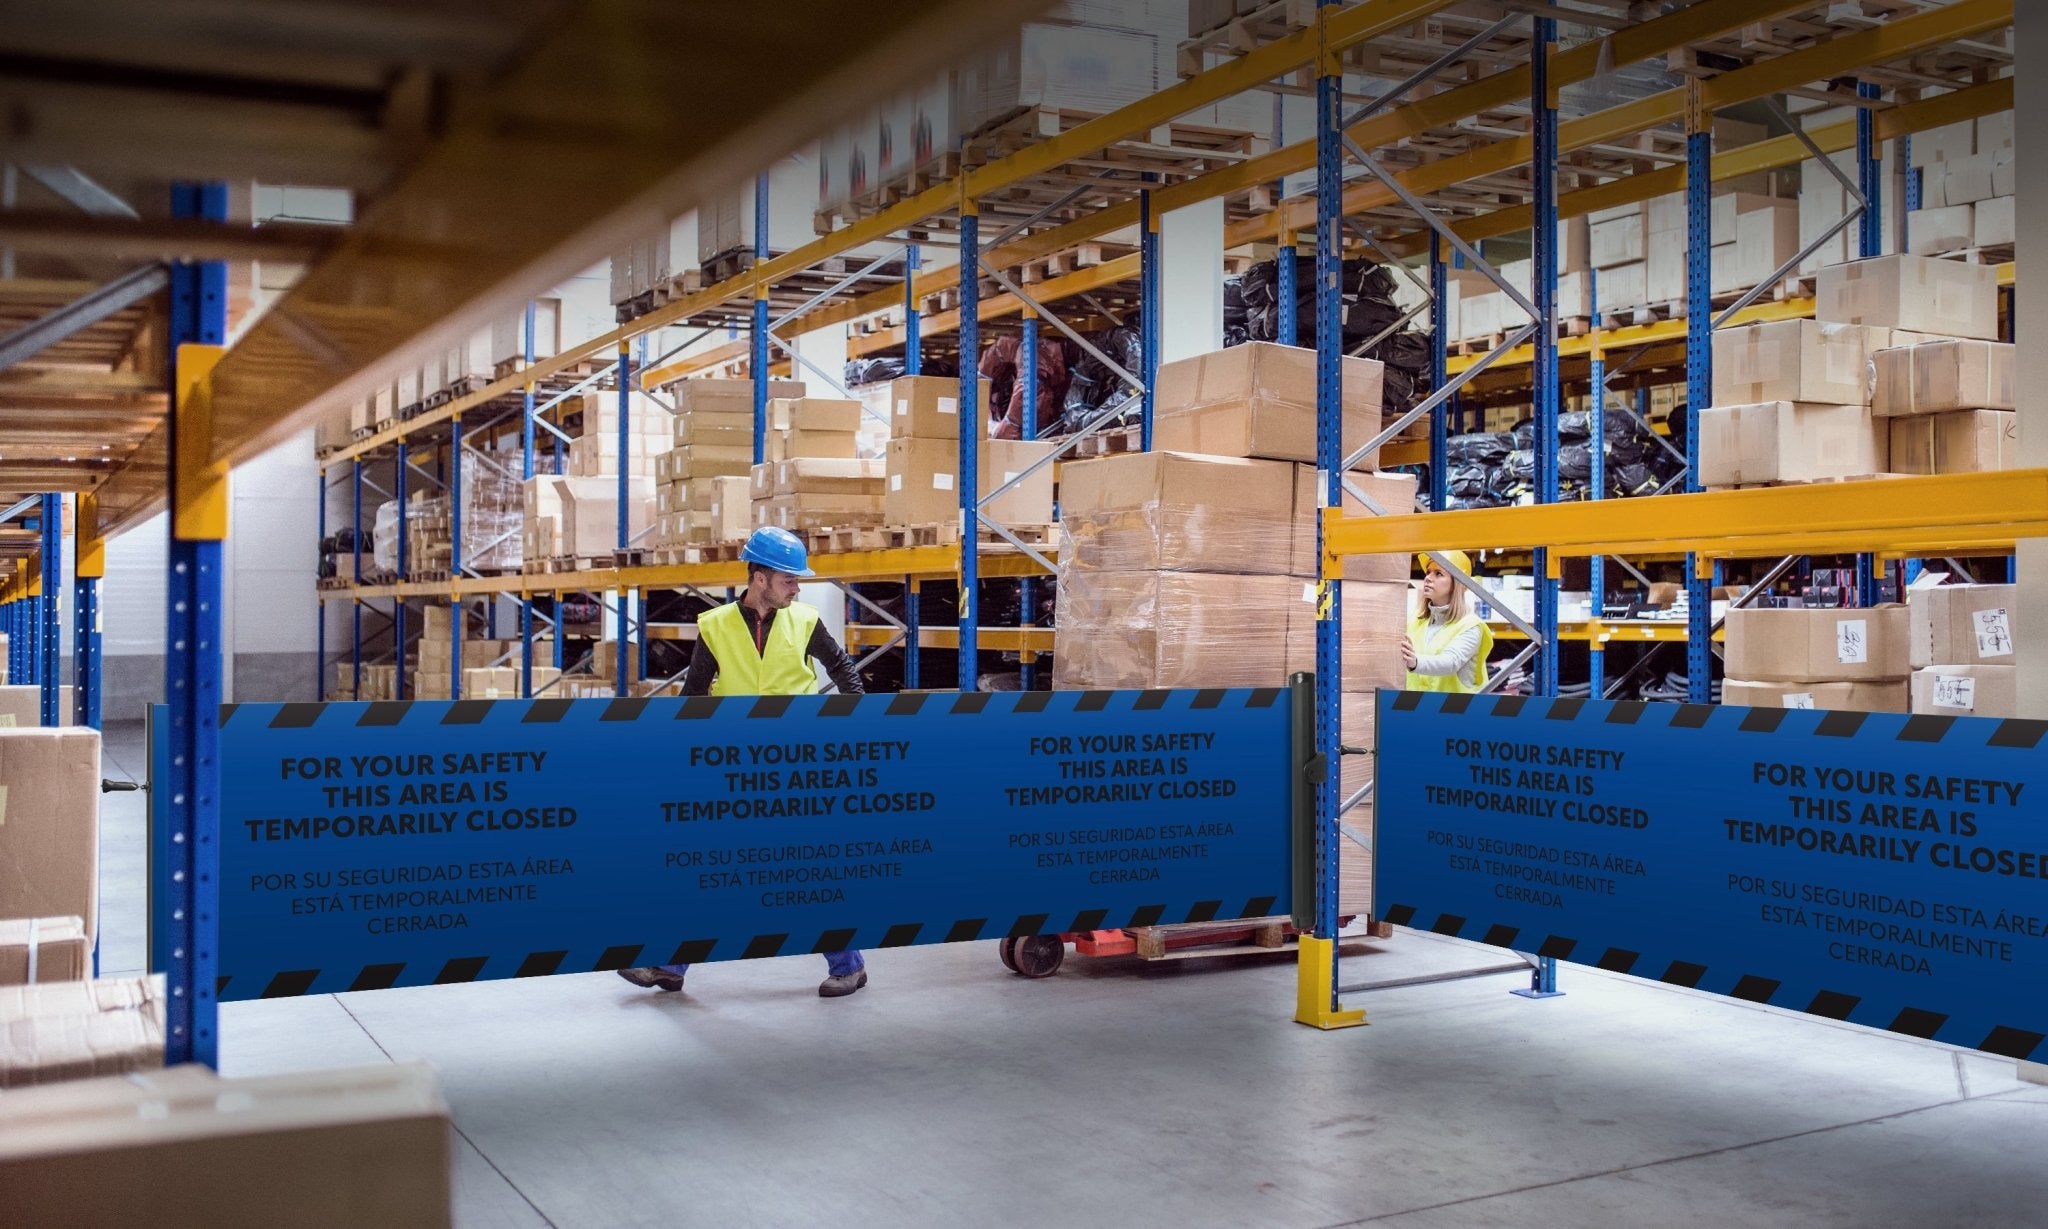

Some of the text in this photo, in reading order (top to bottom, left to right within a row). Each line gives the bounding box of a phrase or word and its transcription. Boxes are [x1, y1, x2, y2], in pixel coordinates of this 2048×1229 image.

[690, 741, 910, 767] FOR YOUR SAFETY
[1030, 732, 1216, 756] FOR YOUR SAFETY
[1445, 738, 1625, 771] FOR YOUR SAFETY
[281, 751, 547, 780] FOR YOUR SAFETY
[724, 767, 878, 792] THIS AREA IS
[1058, 756, 1188, 779] THIS AREA IS
[1469, 764, 1595, 797] THIS AREA IS
[322, 780, 508, 808] THIS AREA IS
[1004, 779, 1236, 806] TEMPORARILY CLOSED
[1753, 762, 2024, 807] FOR YOUR SAFETY
[660, 791, 936, 823] TEMPORARILY CLOSED
[1425, 785, 1649, 830] TEMPORARILY CLOSED
[1788, 795, 1978, 837] THIS AREA IS
[244, 807, 577, 842] TEMPORARILY CLOSED
[1008, 821, 1234, 848] POR SU SEGURIDAD ESTA ÁREA
[665, 837, 933, 868] POR SU SEGURIDAD ESTA ÁREA
[1037, 844, 1208, 868] ESTÁ TEMPORALMENTE
[1427, 830, 1646, 877] POR SU SEGURIDAD ESTA ÁREA
[1723, 818, 1922, 864] TEMPORARILY
[250, 856, 574, 892] POR SU SEGURIDAD ESTA ÁREA
[699, 862, 902, 889] ESTÁ TEMPORALMENTE
[1088, 867, 1160, 885] CERRADA
[1448, 854, 1616, 896] ESTÁ TEMPORALMENTE
[292, 884, 536, 916] ESTÁ TEMPORALMENTE
[760, 888, 845, 907] CERRADA
[1495, 883, 1564, 910] CERRADA
[1728, 873, 1766, 895] POR
[1770, 879, 1796, 900] SU
[1801, 883, 1927, 919] SEGURIDAD
[1932, 903, 1988, 929] ESTA
[367, 912, 468, 935] CERRADA
[1761, 904, 2013, 962] ESTÁ TEMPORALMENTE
[1828, 942, 1933, 976] CERRADA
